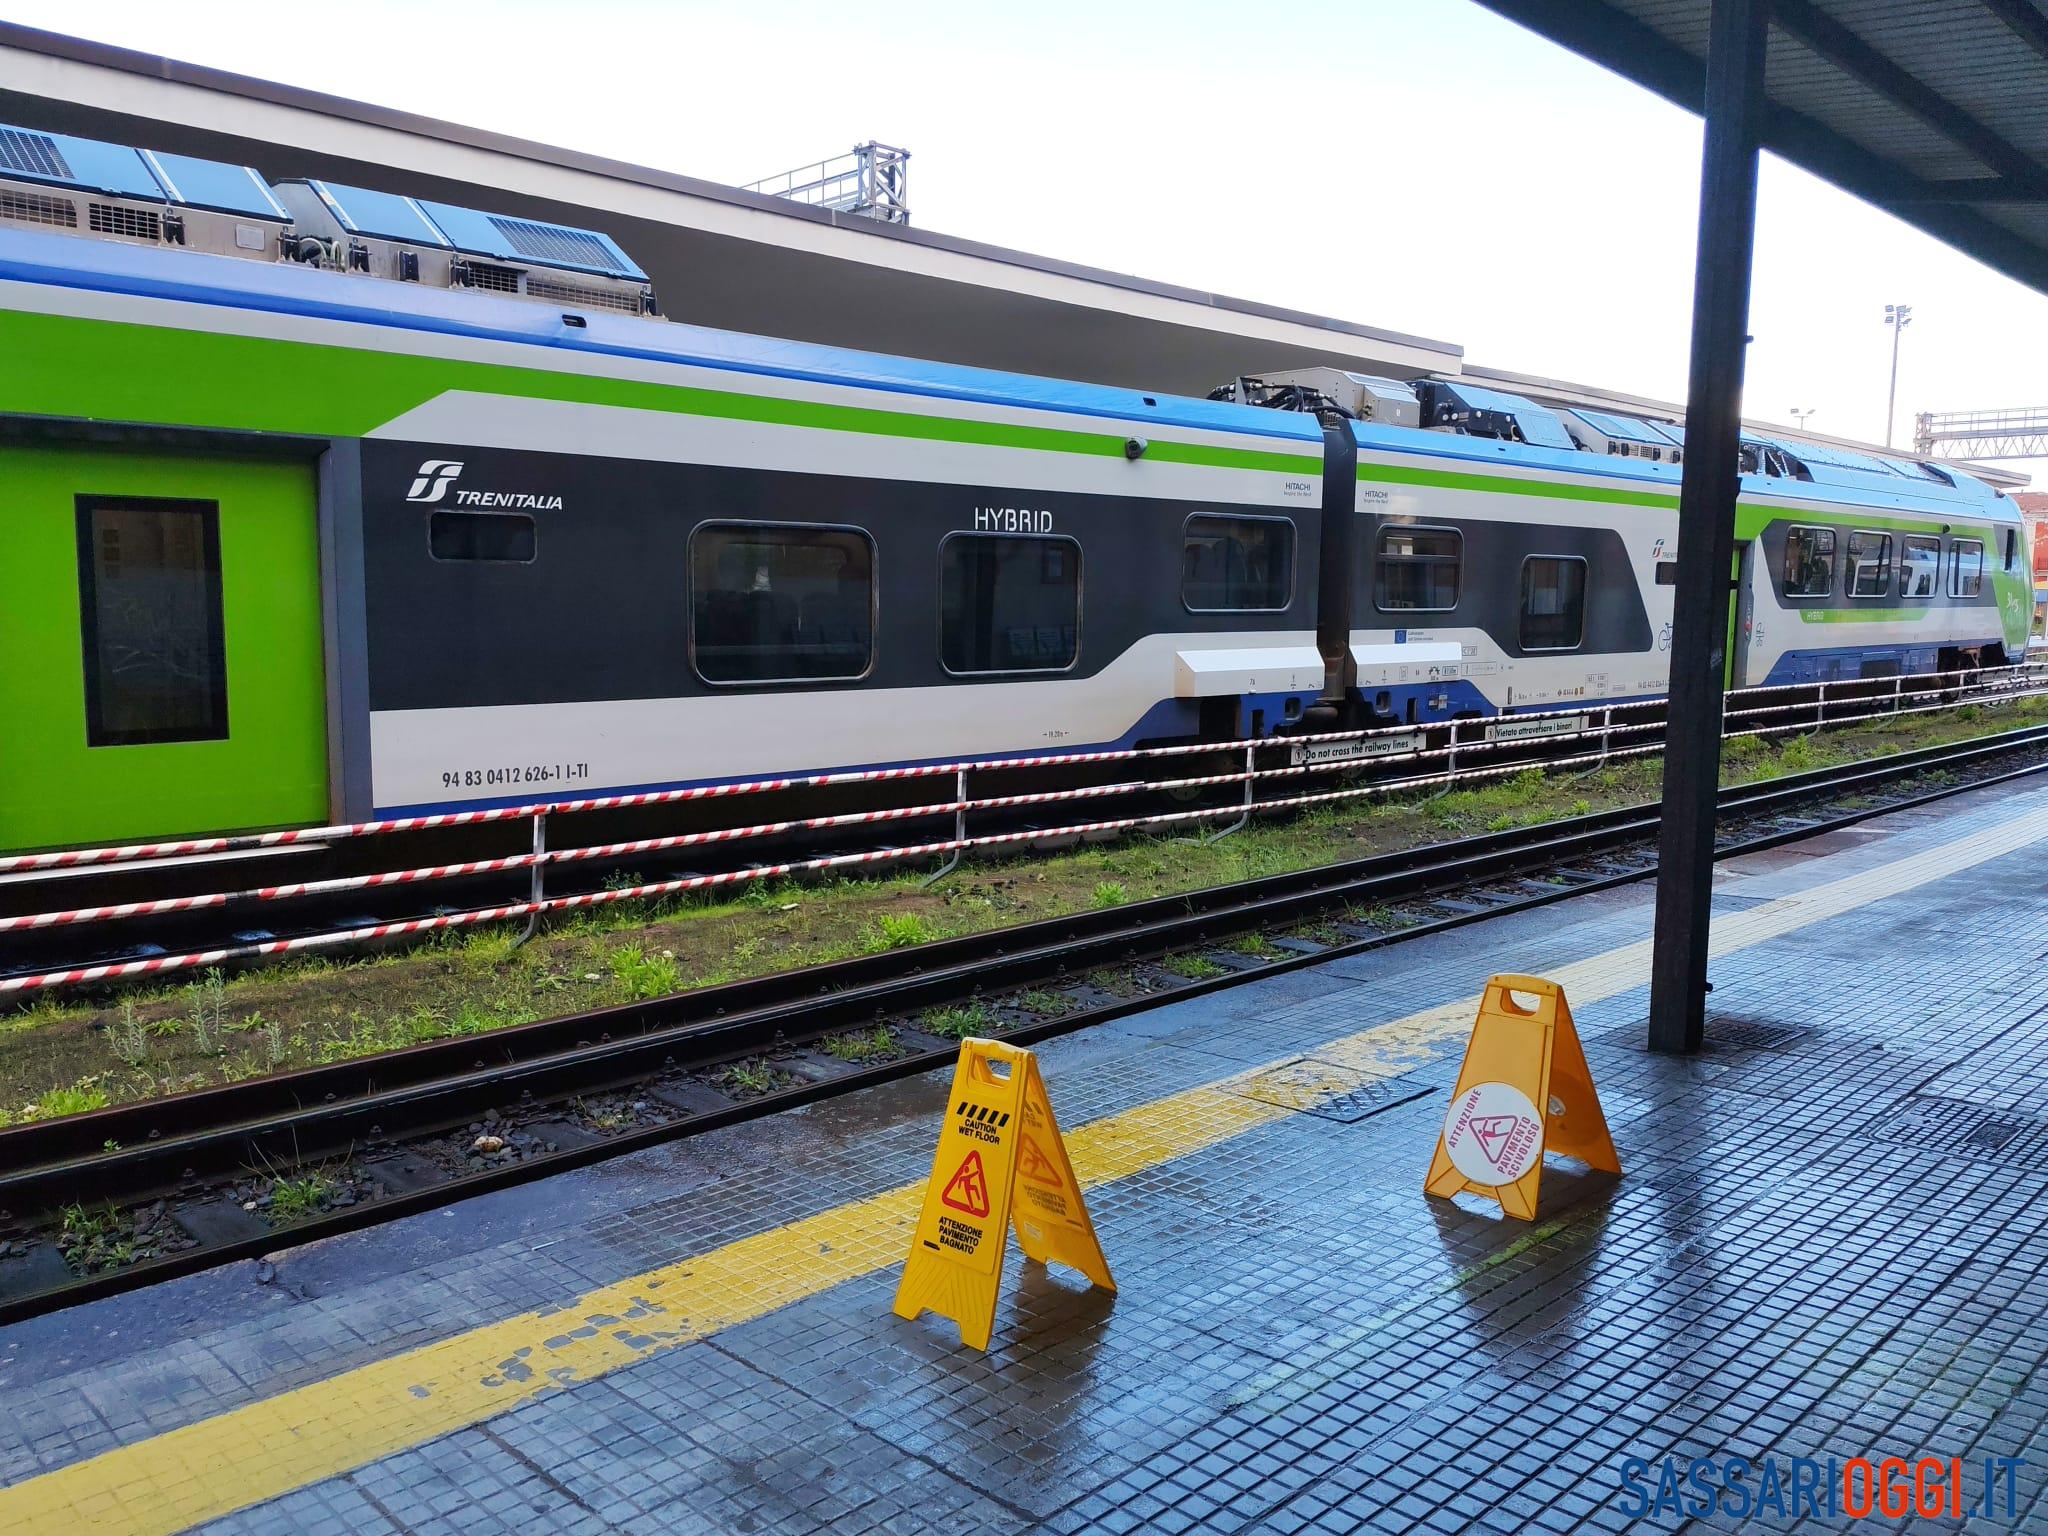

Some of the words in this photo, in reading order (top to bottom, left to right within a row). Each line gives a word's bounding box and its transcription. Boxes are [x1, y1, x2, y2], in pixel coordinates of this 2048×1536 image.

[1285, 482, 1311, 491] HITACHI
[1364, 490, 1389, 499] HITACHI
[456, 490, 563, 510] TRENITALIA
[973, 506, 1053, 533] HYBRID
[1497, 728, 1517, 737] Vietato
[1518, 725, 1552, 735] attraversare
[1556, 721, 1573, 731] binari
[1305, 750, 1316, 760] Do
[1318, 748, 1331, 759] not
[1332, 746, 1350, 756] cross
[1351, 744, 1363, 754] the
[1364, 740, 1391, 753] railway
[1392, 739, 1409, 749] lines
[442, 772, 460, 788] 94
[465, 770, 482, 787] 83
[487, 767, 521, 785] 0412
[524, 765, 561, 782] 626-1
[964, 1118, 997, 1135] CAUTION
[1448, 1088, 1482, 1149] ATTENZIONE
[958, 1125, 974, 1138] WET
[974, 1129, 1000, 1145] FLOOR
[1496, 1115, 1531, 1175] PAVIMENTO
[1507, 1123, 1540, 1178] SCIVOLOSO
[938, 1215, 983, 1238] ATTENZIONE
[938, 1225, 979, 1246] PAVIMENTO
[939, 1234, 975, 1255] BAGNATO
